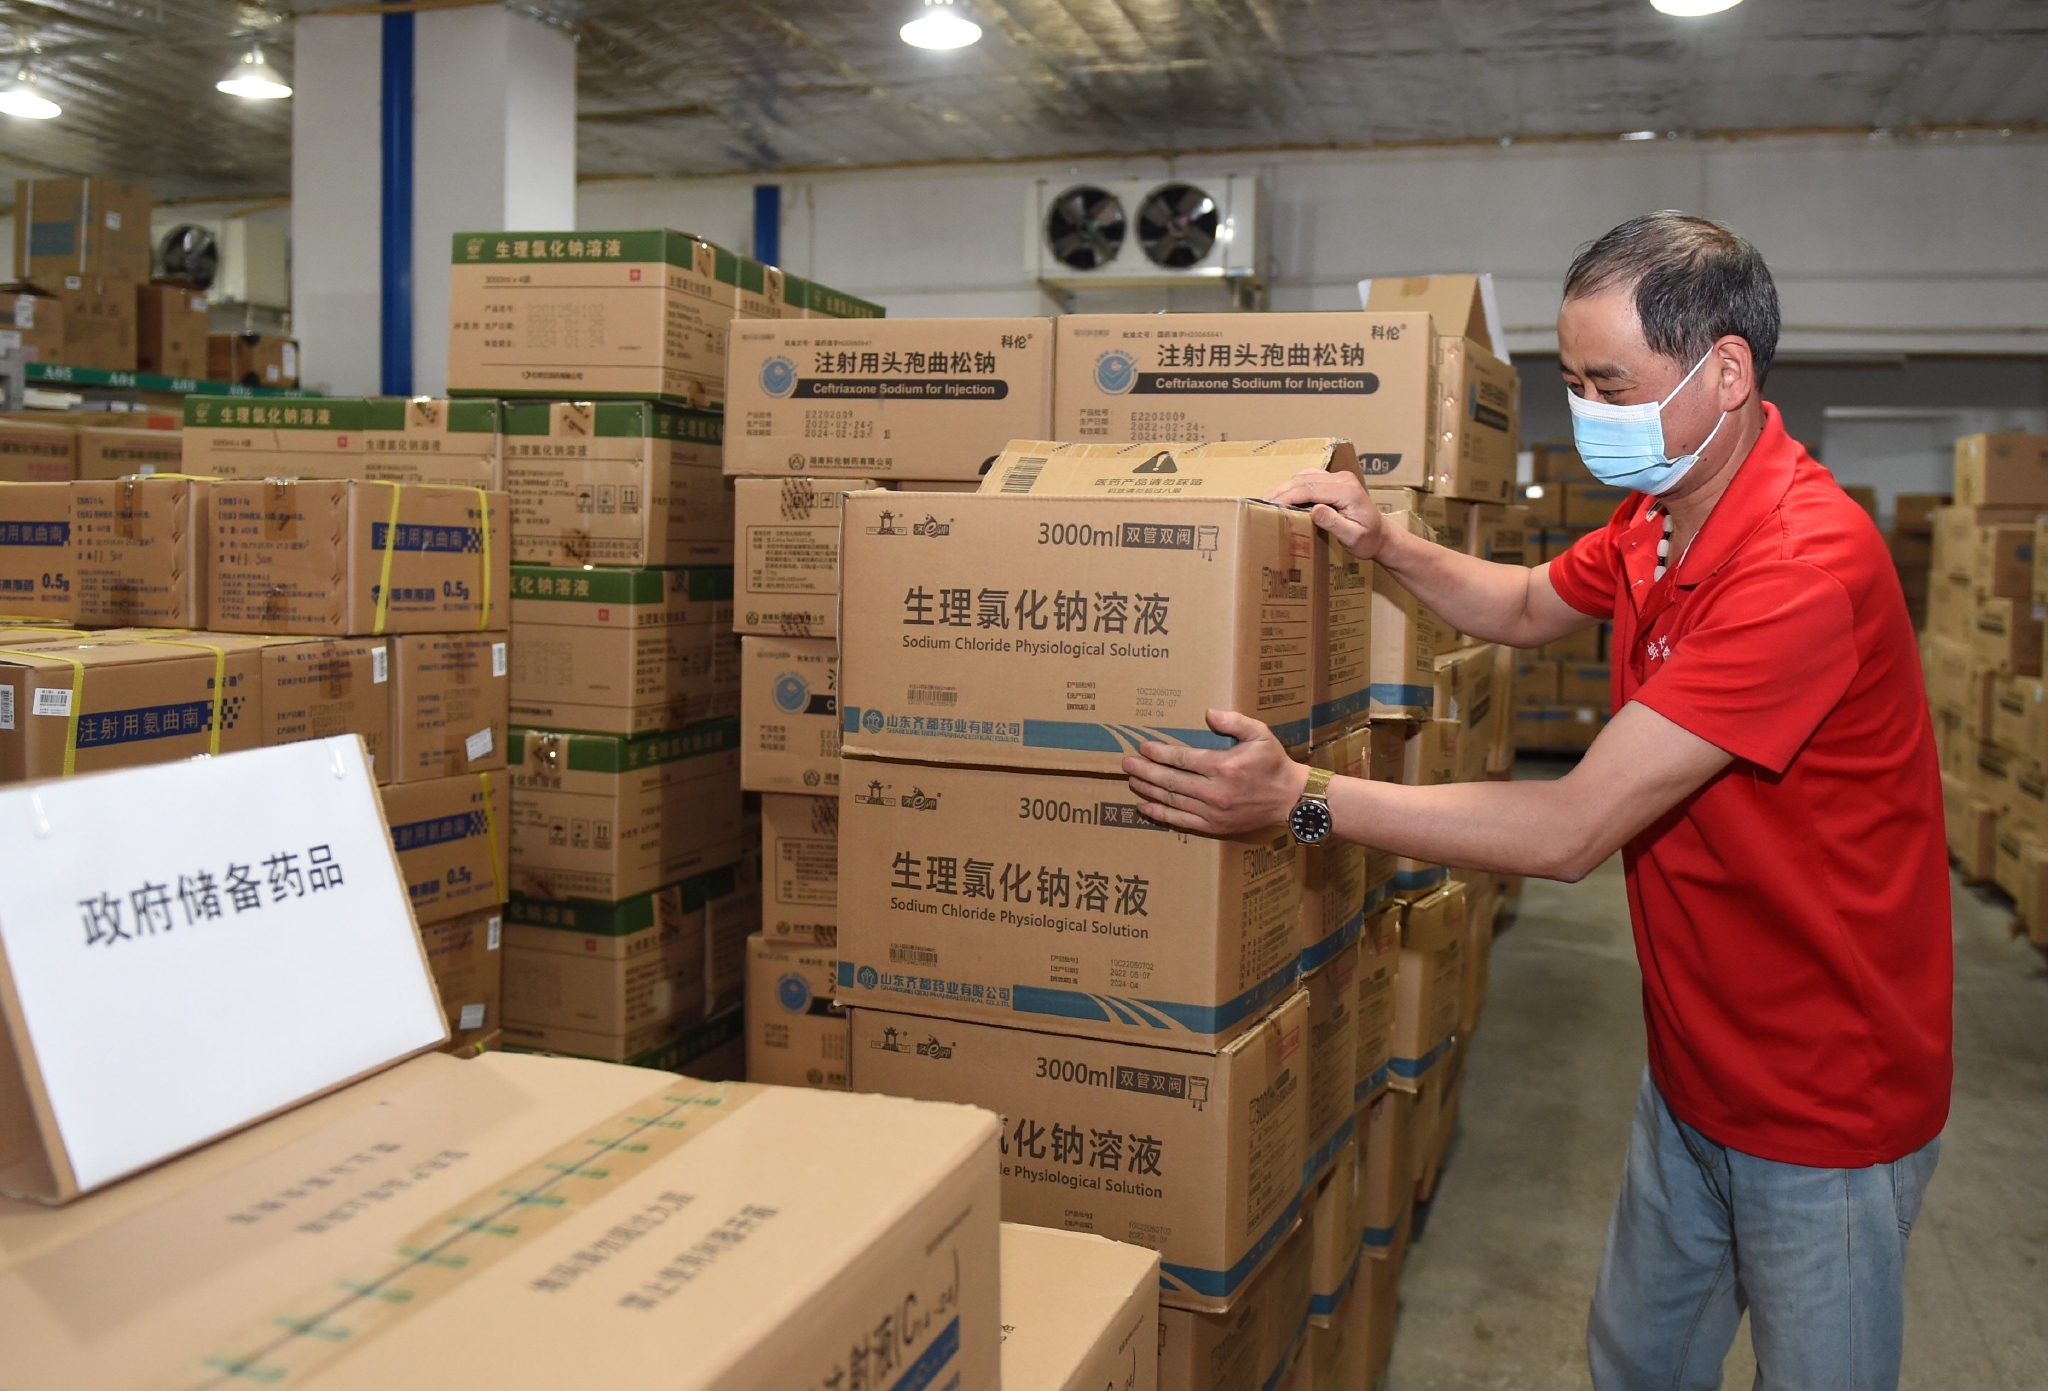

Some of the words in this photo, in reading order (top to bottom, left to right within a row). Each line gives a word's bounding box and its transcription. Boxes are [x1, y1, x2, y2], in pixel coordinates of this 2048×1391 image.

[495, 239, 622, 259] 生理氯化钠溶液
[814, 351, 996, 375] 注射用头孢曲松钠
[1157, 343, 1366, 369] 注射用头孢曲松钠
[44, 367, 73, 381] A05
[1155, 377, 1229, 389] Ceftriaxone
[1231, 377, 1282, 389] Sodium
[1284, 377, 1304, 389] for
[1306, 377, 1364, 391] Injection
[813, 382, 877, 395] Ceftriaxone
[879, 383, 923, 395] Sodium
[926, 383, 942, 395] for
[945, 384, 995, 396] Injection
[220, 406, 331, 425] 生理氯化钠溶液
[1131, 411, 1186, 421] E2202009
[366, 440, 442, 452] 生理氯化钠溶液
[508, 444, 588, 457] 生理氯化钠溶液
[1094, 478, 1204, 486] 医药产品请勿踩踏
[1037, 521, 1119, 547] 3000ml
[1125, 525, 1193, 547] 双管双阀
[42, 573, 70, 591] 0.5g
[443, 580, 469, 600] 0.5g
[903, 585, 1170, 636] 生理氯化钠溶液
[902, 635, 951, 651] Sodium
[955, 636, 1011, 653] Chloride
[1016, 639, 1105, 659] Physiological
[1109, 642, 1169, 659] Solution
[1135, 709, 1152, 717] 2024
[79, 707, 200, 743] 注射用氨曲南
[887, 714, 1020, 737] 山东齐都药业有限公司
[1018, 796, 1099, 826] 3000ml
[446, 866, 472, 886] 0.5g
[890, 851, 1150, 919] 生理氯化钠溶液
[77, 844, 346, 947] 政府储备药品
[891, 896, 938, 916] Sodium
[942, 903, 996, 923] Chloride
[1000, 911, 1087, 934] Physiological
[1091, 920, 1149, 940] Solution
[880, 972, 1010, 1001] 山东齐都药业有限公司
[1035, 1056, 1115, 1089] 3000ml
[1119, 1069, 1185, 1095] 双管双阀
[1014, 1163, 1101, 1190] Physiological
[1104, 1177, 1163, 1199] Solution
